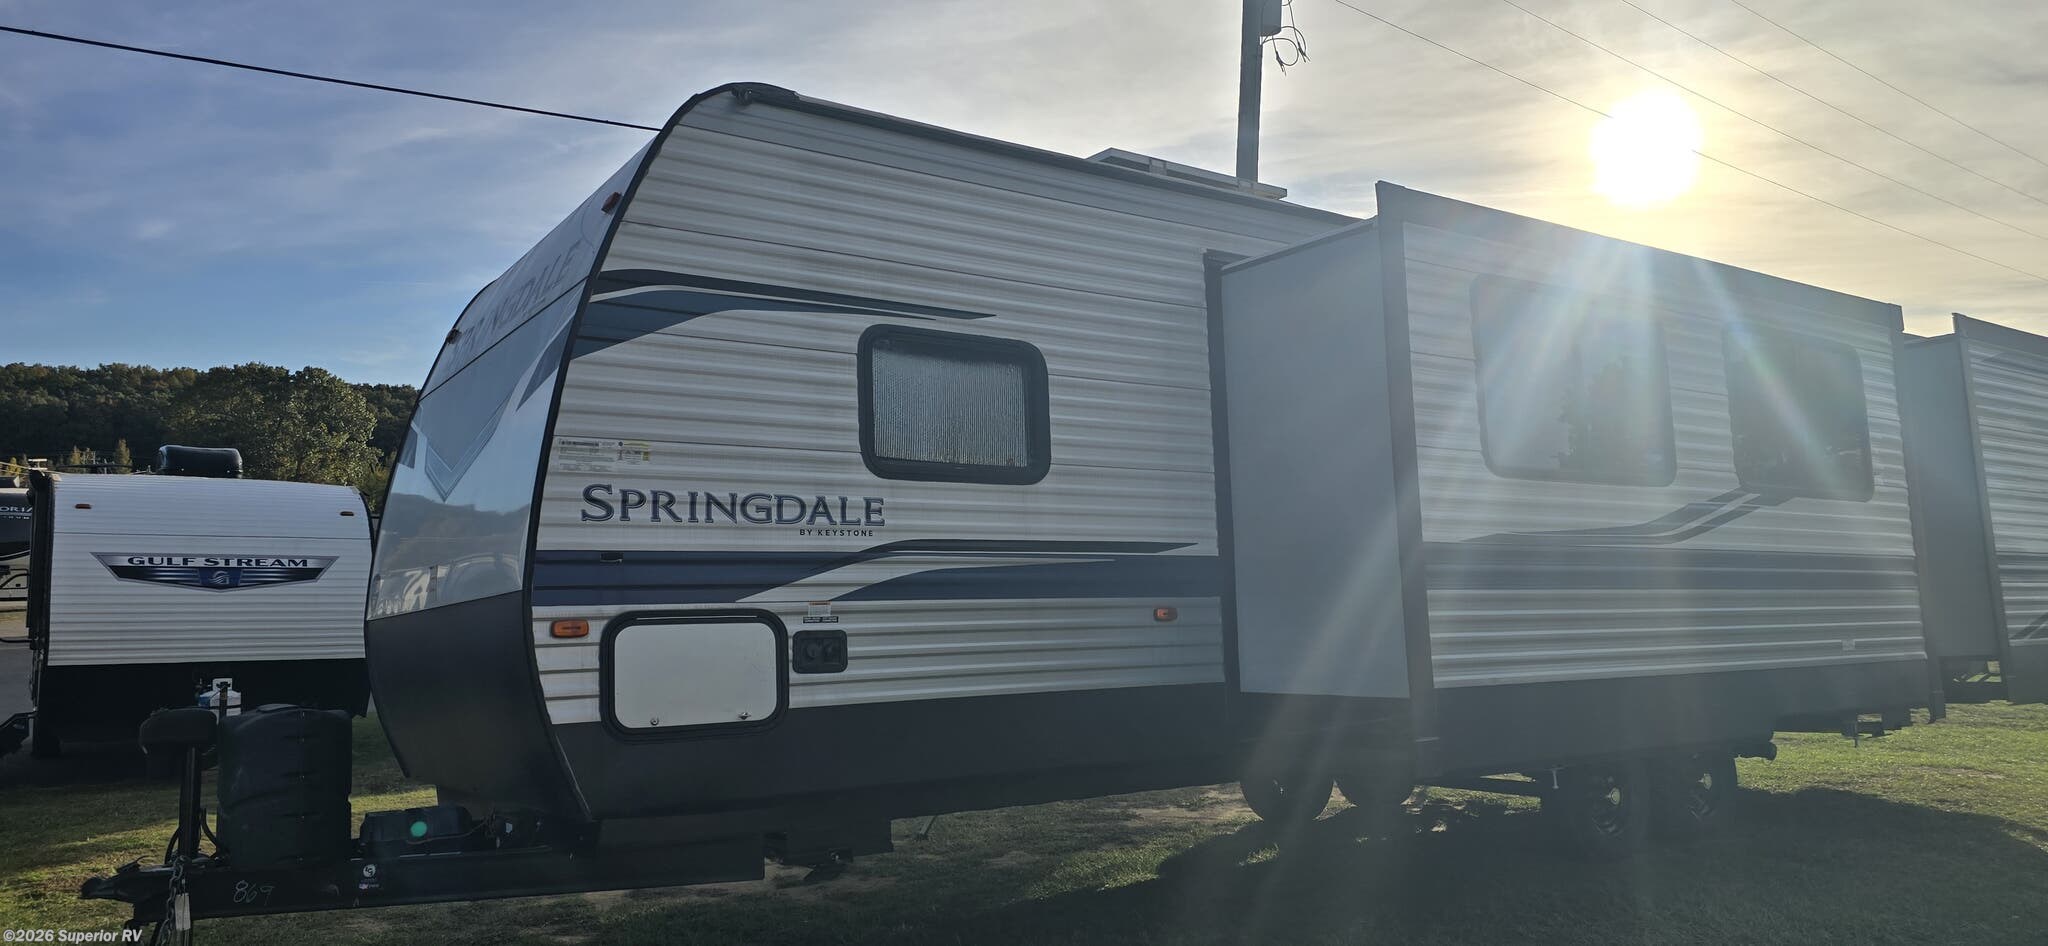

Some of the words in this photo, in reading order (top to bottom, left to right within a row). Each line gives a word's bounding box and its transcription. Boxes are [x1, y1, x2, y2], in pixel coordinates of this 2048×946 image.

[581, 483, 886, 527] SPRINGDALE
[128, 556, 195, 566] GULF
[204, 557, 308, 567] STREAM
